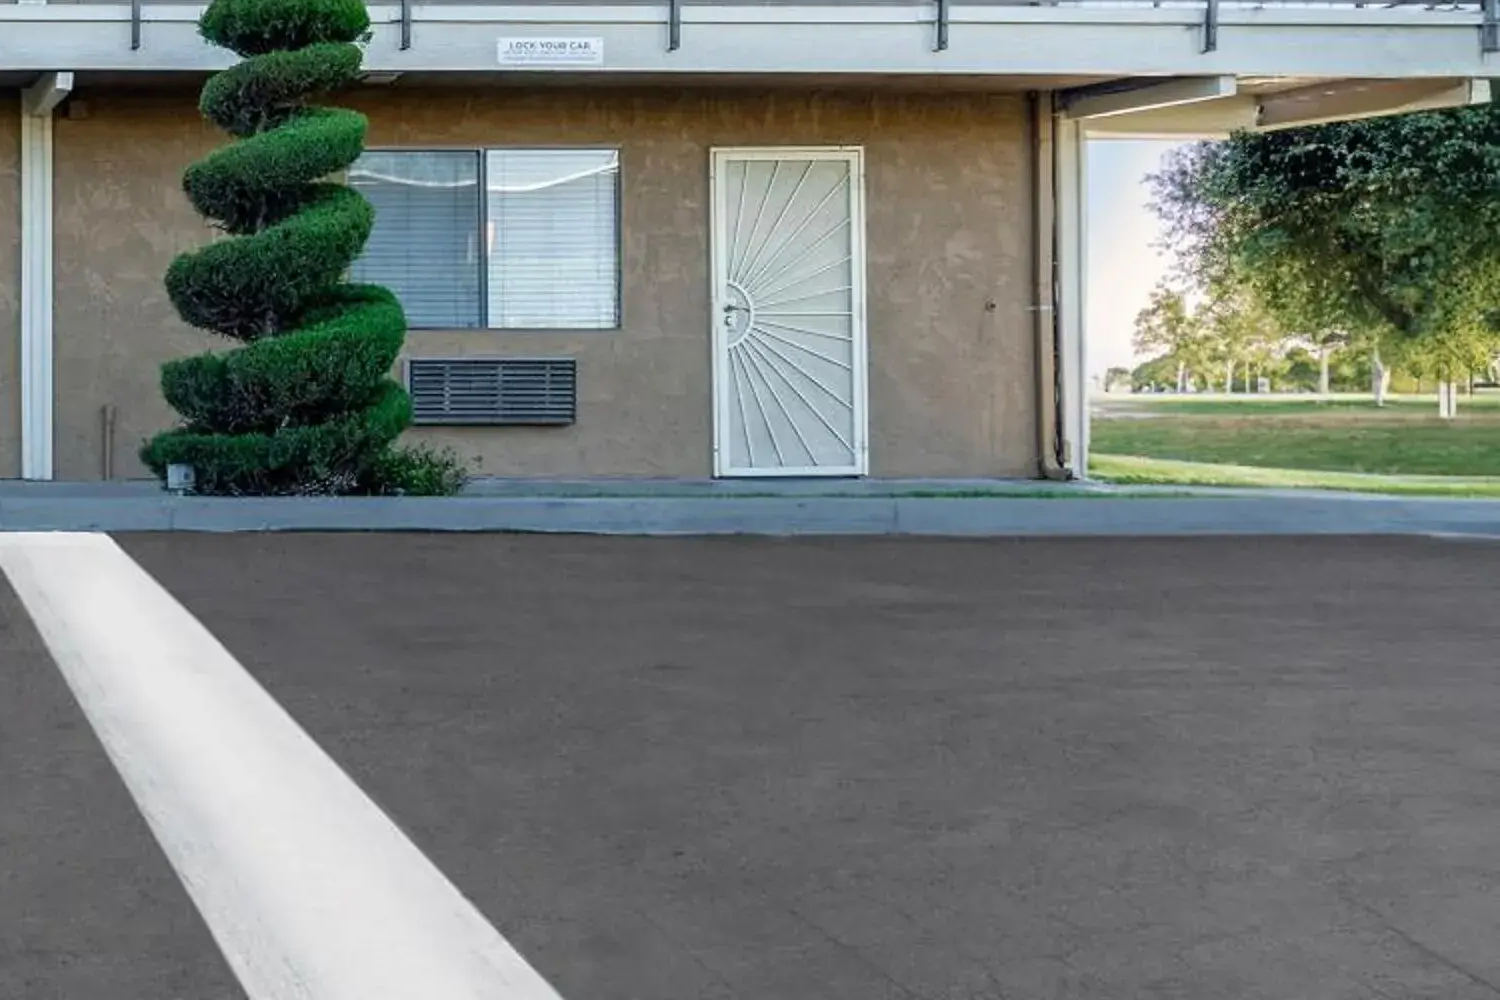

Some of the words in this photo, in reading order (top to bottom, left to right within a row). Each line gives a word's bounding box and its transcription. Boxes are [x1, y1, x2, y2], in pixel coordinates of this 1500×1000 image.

[509, 41, 536, 50] LOCK
[540, 41, 567, 50] YOUR
[570, 41, 591, 50] CAR
